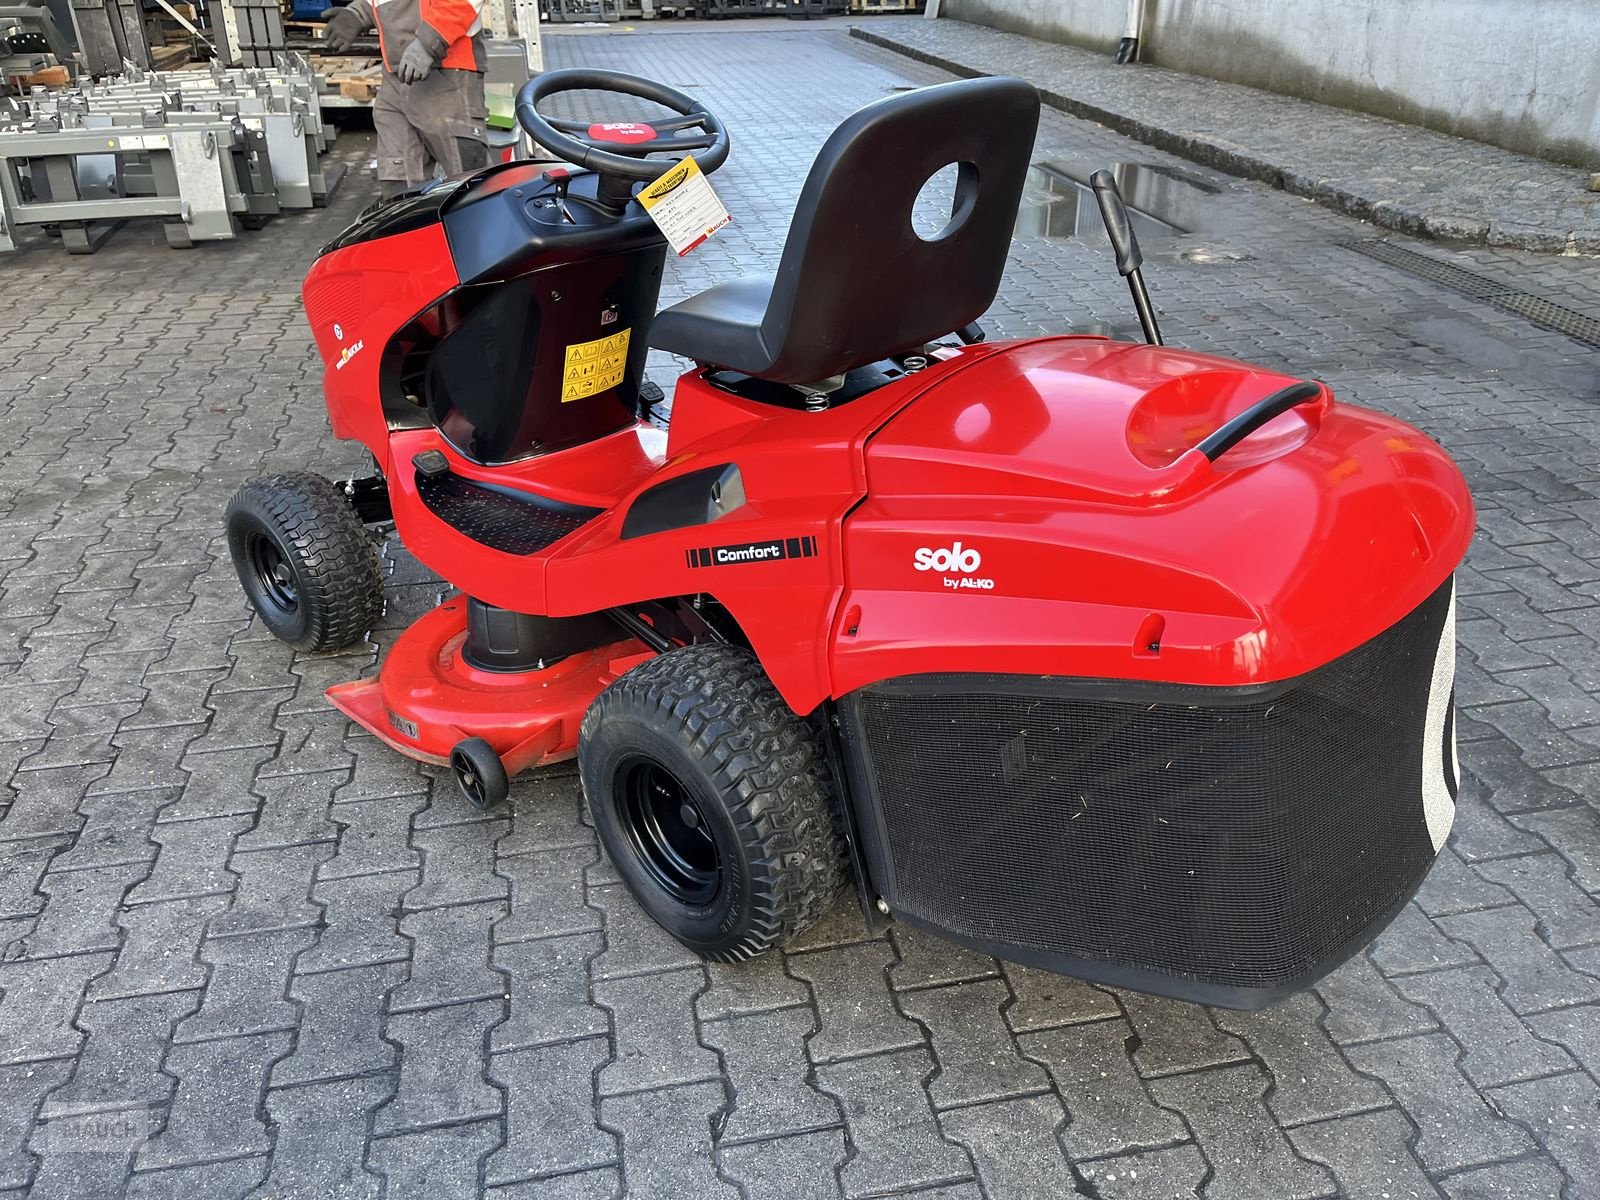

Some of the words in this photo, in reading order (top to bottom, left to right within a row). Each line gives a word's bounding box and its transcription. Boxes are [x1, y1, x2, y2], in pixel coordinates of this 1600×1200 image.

[707, 218, 728, 235] MAUCH
[717, 545, 780, 562] Comfort
[913, 541, 981, 573] solo
[943, 576, 959, 590] by
